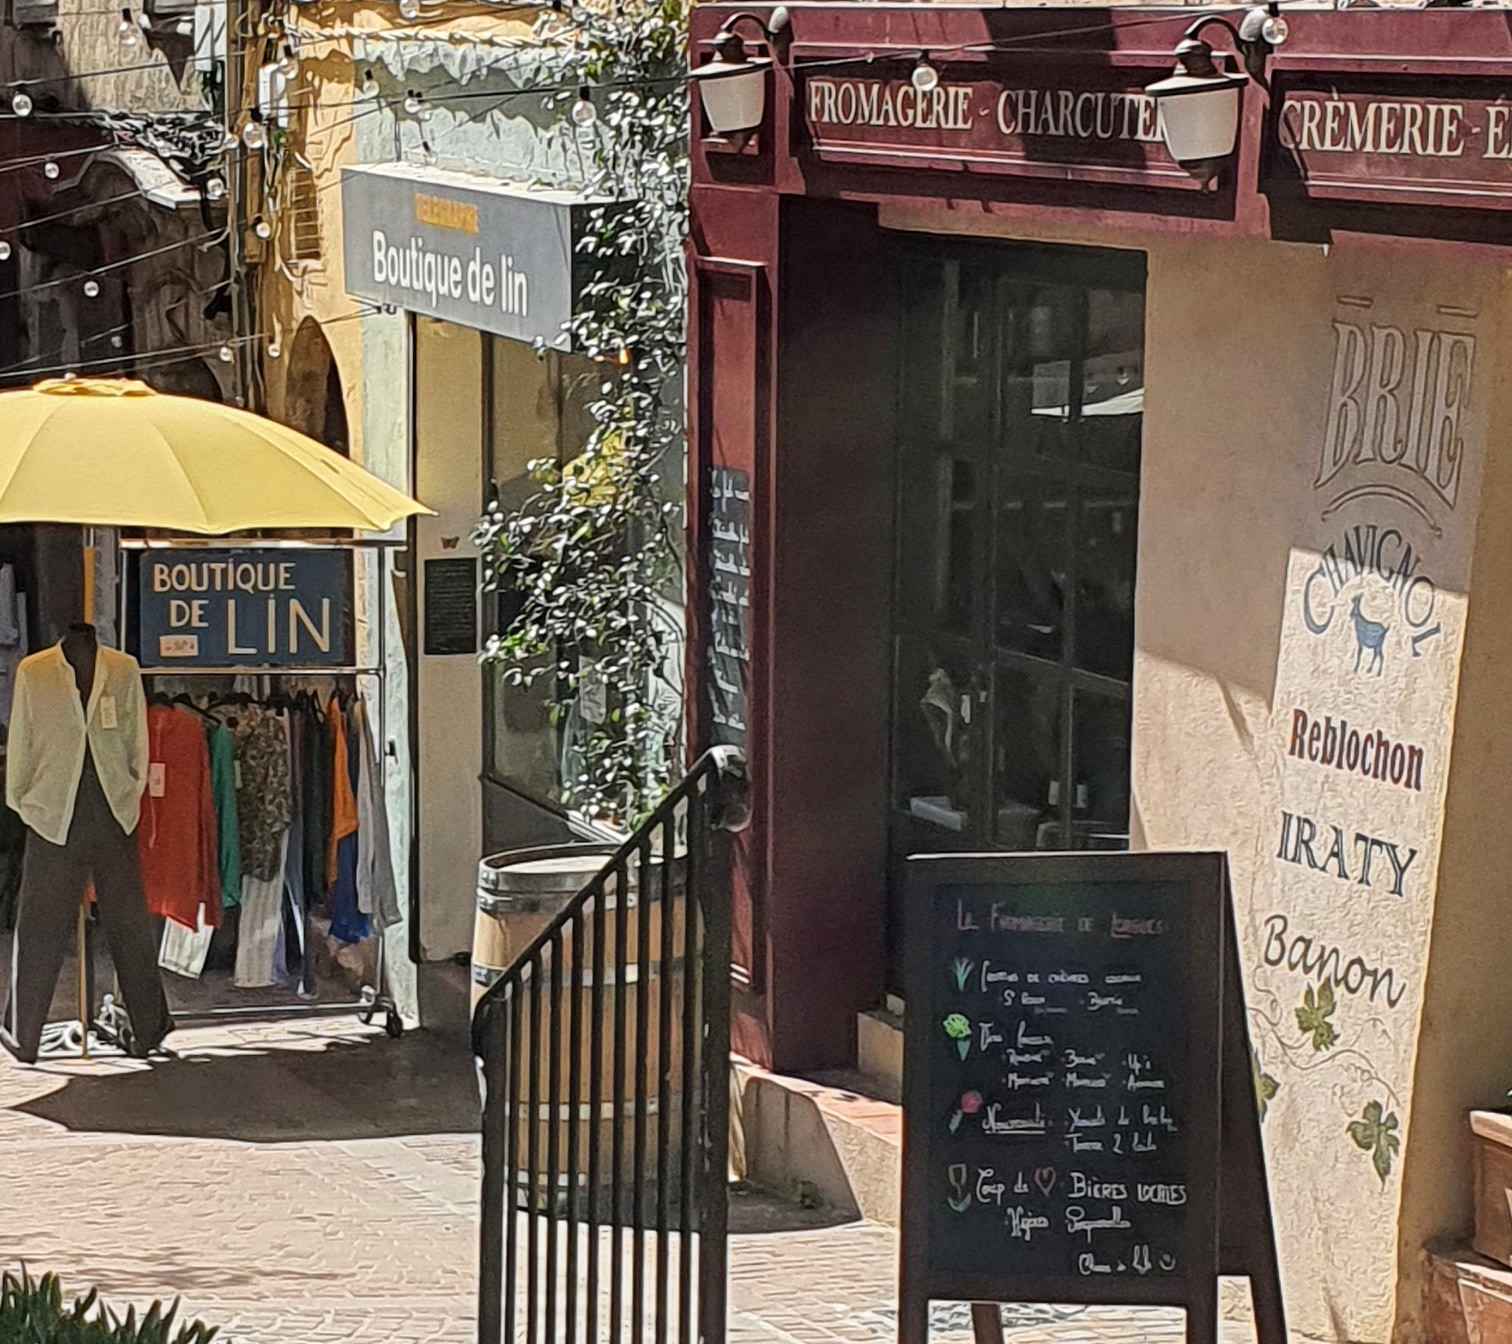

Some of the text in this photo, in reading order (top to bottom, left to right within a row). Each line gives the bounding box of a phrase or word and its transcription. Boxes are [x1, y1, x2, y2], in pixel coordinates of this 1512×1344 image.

[809, 80, 973, 130] FROMAGERIE
[996, 89, 1166, 142] CHARCUTE
[1280, 84, 1464, 156] CRÈMERIE
[372, 230, 529, 317] Boutique de lin
[1313, 318, 1478, 511] BRIE
[170, 599, 210, 628] DE
[1303, 524, 1442, 657] CHAVIGNOL
[1288, 708, 1425, 792] Reblochon
[1276, 810, 1418, 898] IRATY
[1263, 914, 1407, 1008] Banon
